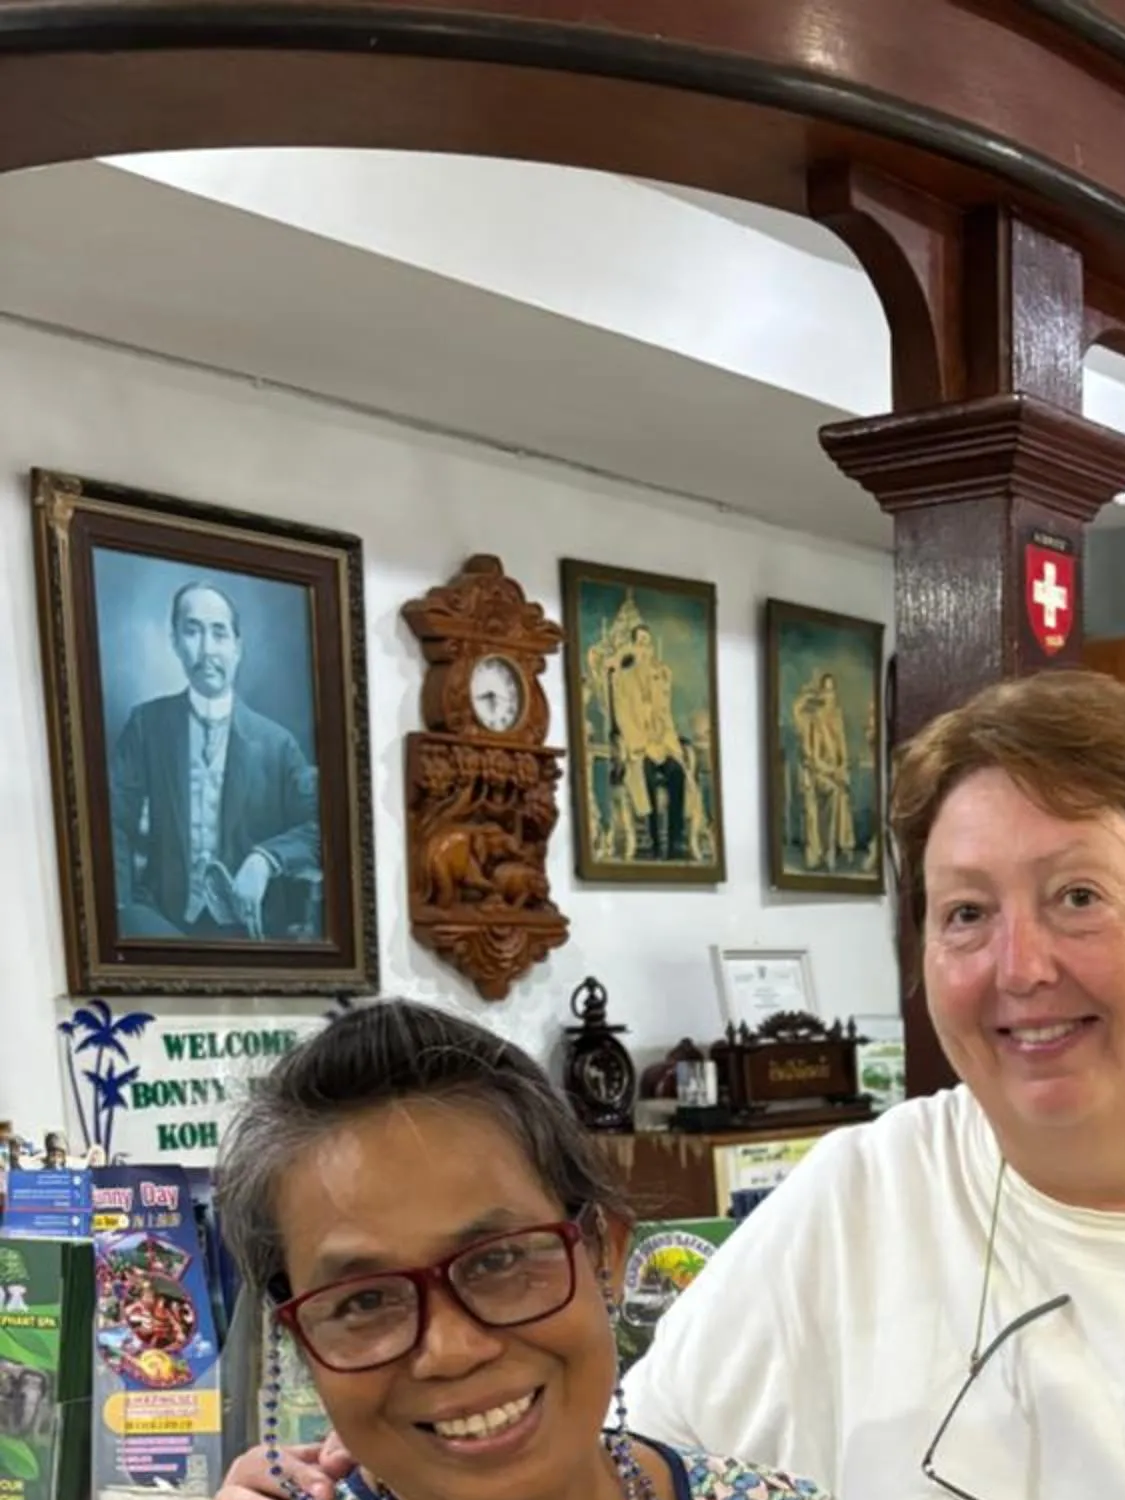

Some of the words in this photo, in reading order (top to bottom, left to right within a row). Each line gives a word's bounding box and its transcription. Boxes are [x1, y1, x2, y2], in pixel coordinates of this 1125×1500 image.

[162, 1029, 297, 1060] WELCOME
[130, 1078, 226, 1110] BONNY
[156, 1122, 218, 1151] KOH
[140, 1182, 179, 1210] Day
